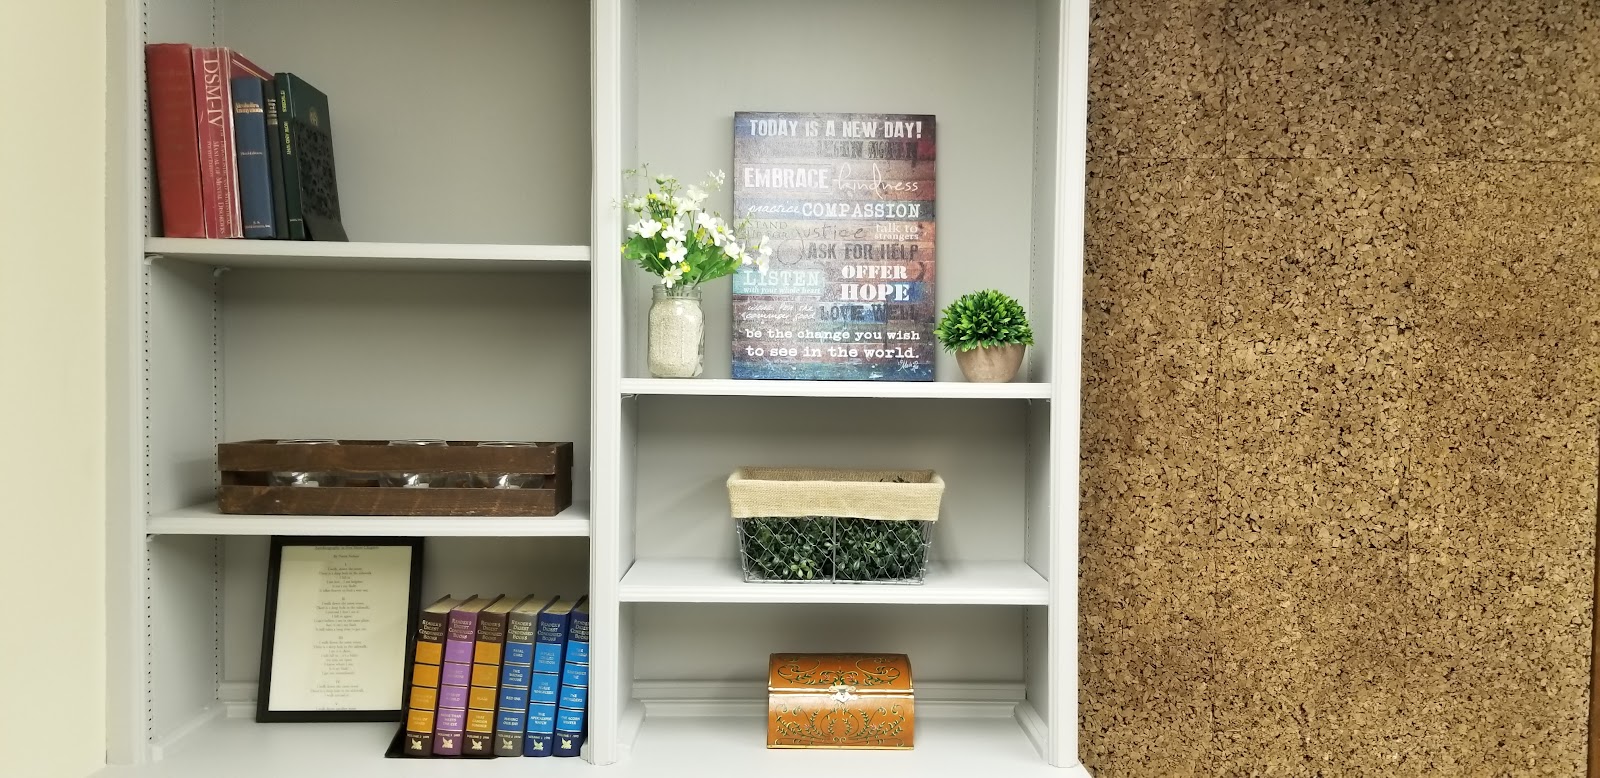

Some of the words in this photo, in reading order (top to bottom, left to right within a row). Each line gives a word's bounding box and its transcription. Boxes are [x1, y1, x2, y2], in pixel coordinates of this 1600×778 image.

[203, 58, 223, 127] DSM-IV
[749, 119, 798, 136] TODAY
[805, 120, 819, 137] IS
[825, 120, 836, 137] A
[842, 121, 877, 138] NEW
[884, 121, 922, 139] DAY!
[744, 167, 829, 190] EMBRACE
[836, 162, 919, 199] kindness
[748, 202, 800, 216] practice
[802, 202, 920, 218] COMPASSION
[876, 222, 901, 232] talk
[904, 224, 918, 233] to
[874, 232, 919, 242] strangers
[806, 242, 836, 260] ASK
[844, 243, 874, 260] FOR
[880, 243, 918, 260] HELP
[743, 270, 820, 286] LISTEN
[842, 264, 908, 280] OFFER
[840, 284, 910, 301] HOPE
[798, 303, 814, 312] the
[820, 305, 864, 321] LOVE
[745, 328, 762, 338] be
[766, 328, 793, 339] the
[798, 330, 850, 342] change
[854, 332, 882, 342] you
[886, 330, 920, 340] wish
[746, 346, 764, 356] to
[770, 348, 798, 356] see
[803, 346, 822, 358] in
[828, 346, 859, 358] the
[863, 347, 920, 358] world.
